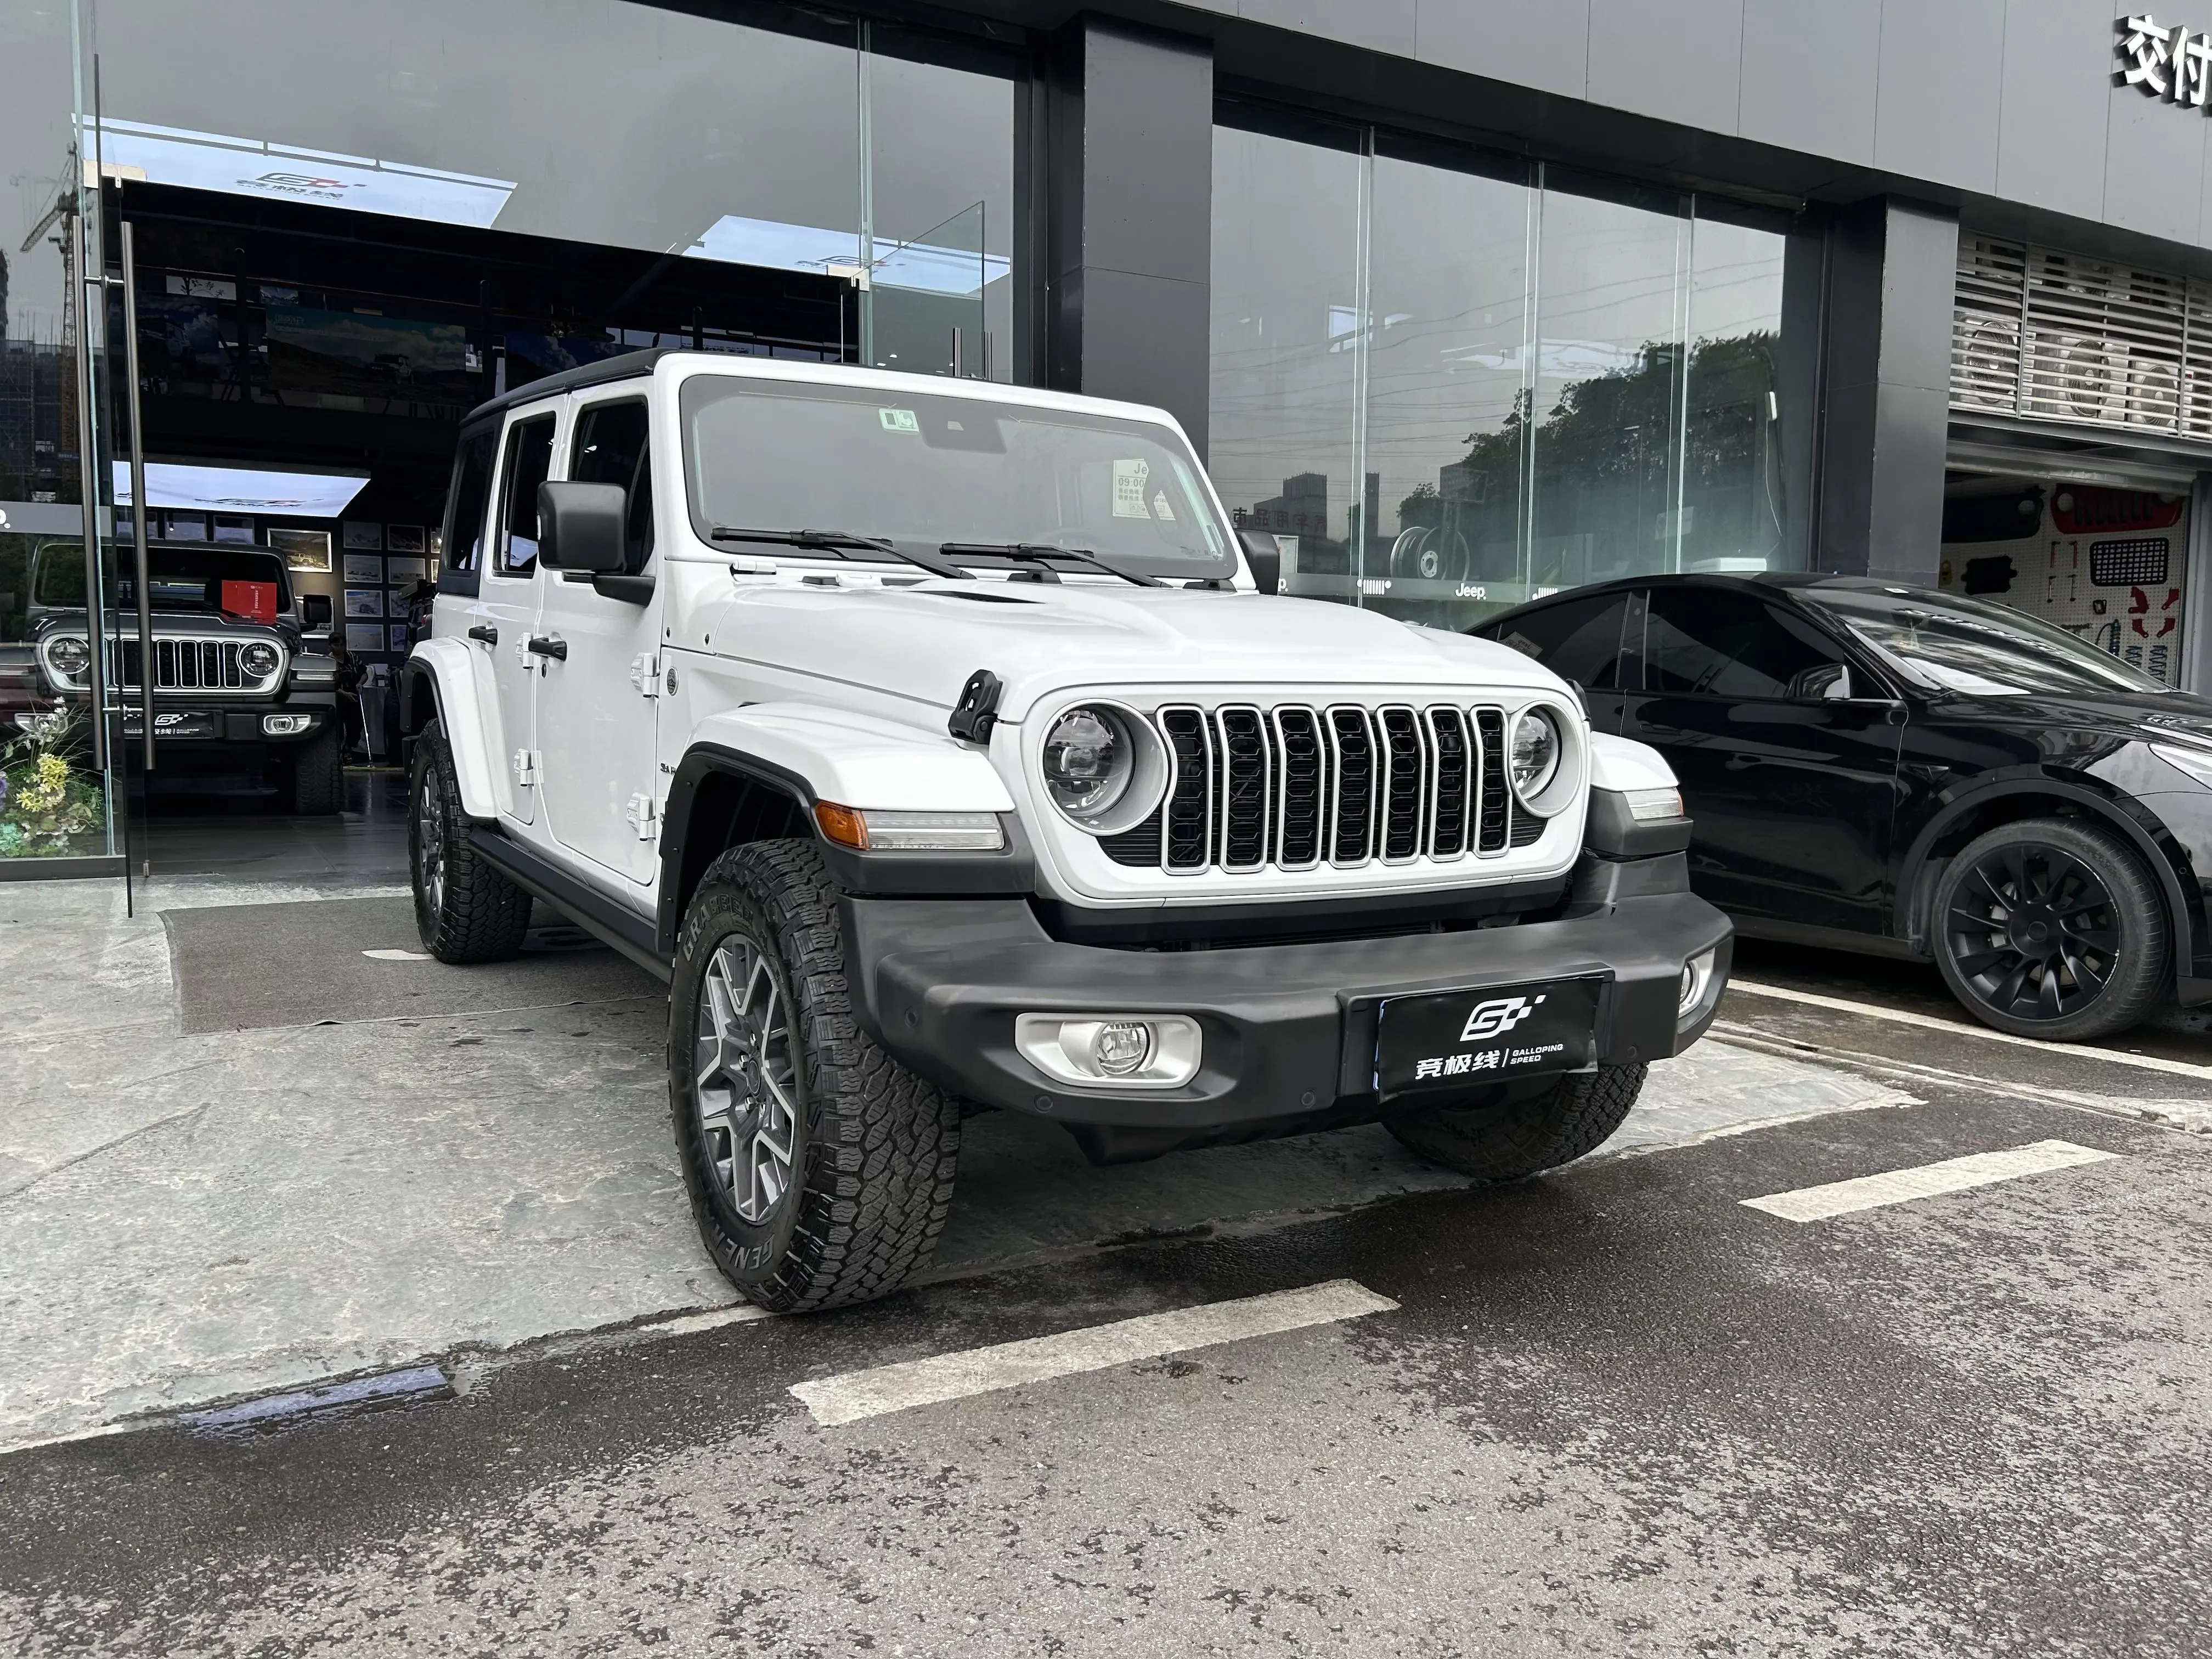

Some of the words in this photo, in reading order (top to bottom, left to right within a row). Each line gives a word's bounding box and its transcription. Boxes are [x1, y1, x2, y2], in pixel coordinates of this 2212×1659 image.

[2122, 14, 2212, 105] 交付
[1513, 1043, 1564, 1057] GALLOPING
[1510, 1054, 1542, 1065] SPEED
